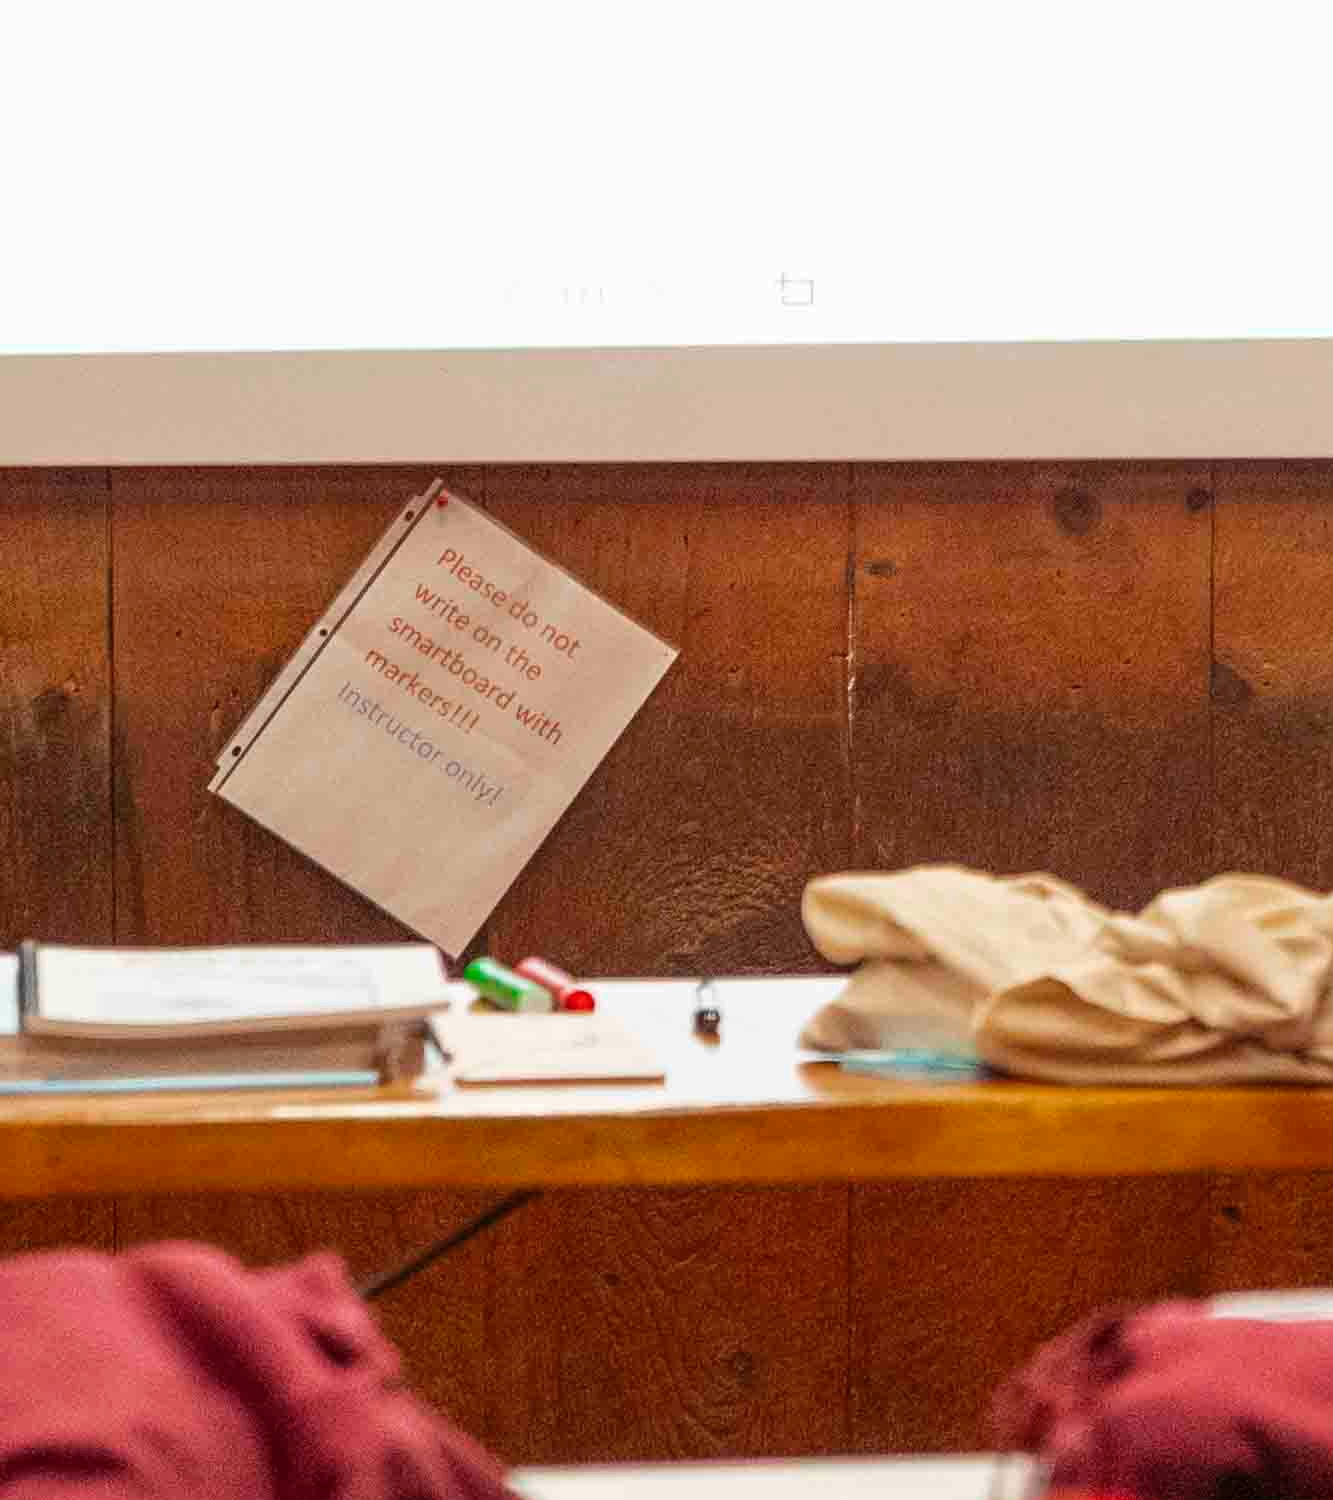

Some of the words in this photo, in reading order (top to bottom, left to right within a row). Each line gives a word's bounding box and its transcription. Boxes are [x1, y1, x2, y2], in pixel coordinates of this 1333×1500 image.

[415, 583, 470, 630] write
[473, 626, 502, 652] on
[504, 646, 543, 681] the
[438, 548, 508, 607] Please
[508, 601, 538, 628] do
[541, 623, 582, 658] not
[338, 681, 442, 762] Instructor
[365, 649, 481, 734] markers!!!
[388, 616, 517, 711] smartboard
[515, 704, 563, 745] with
